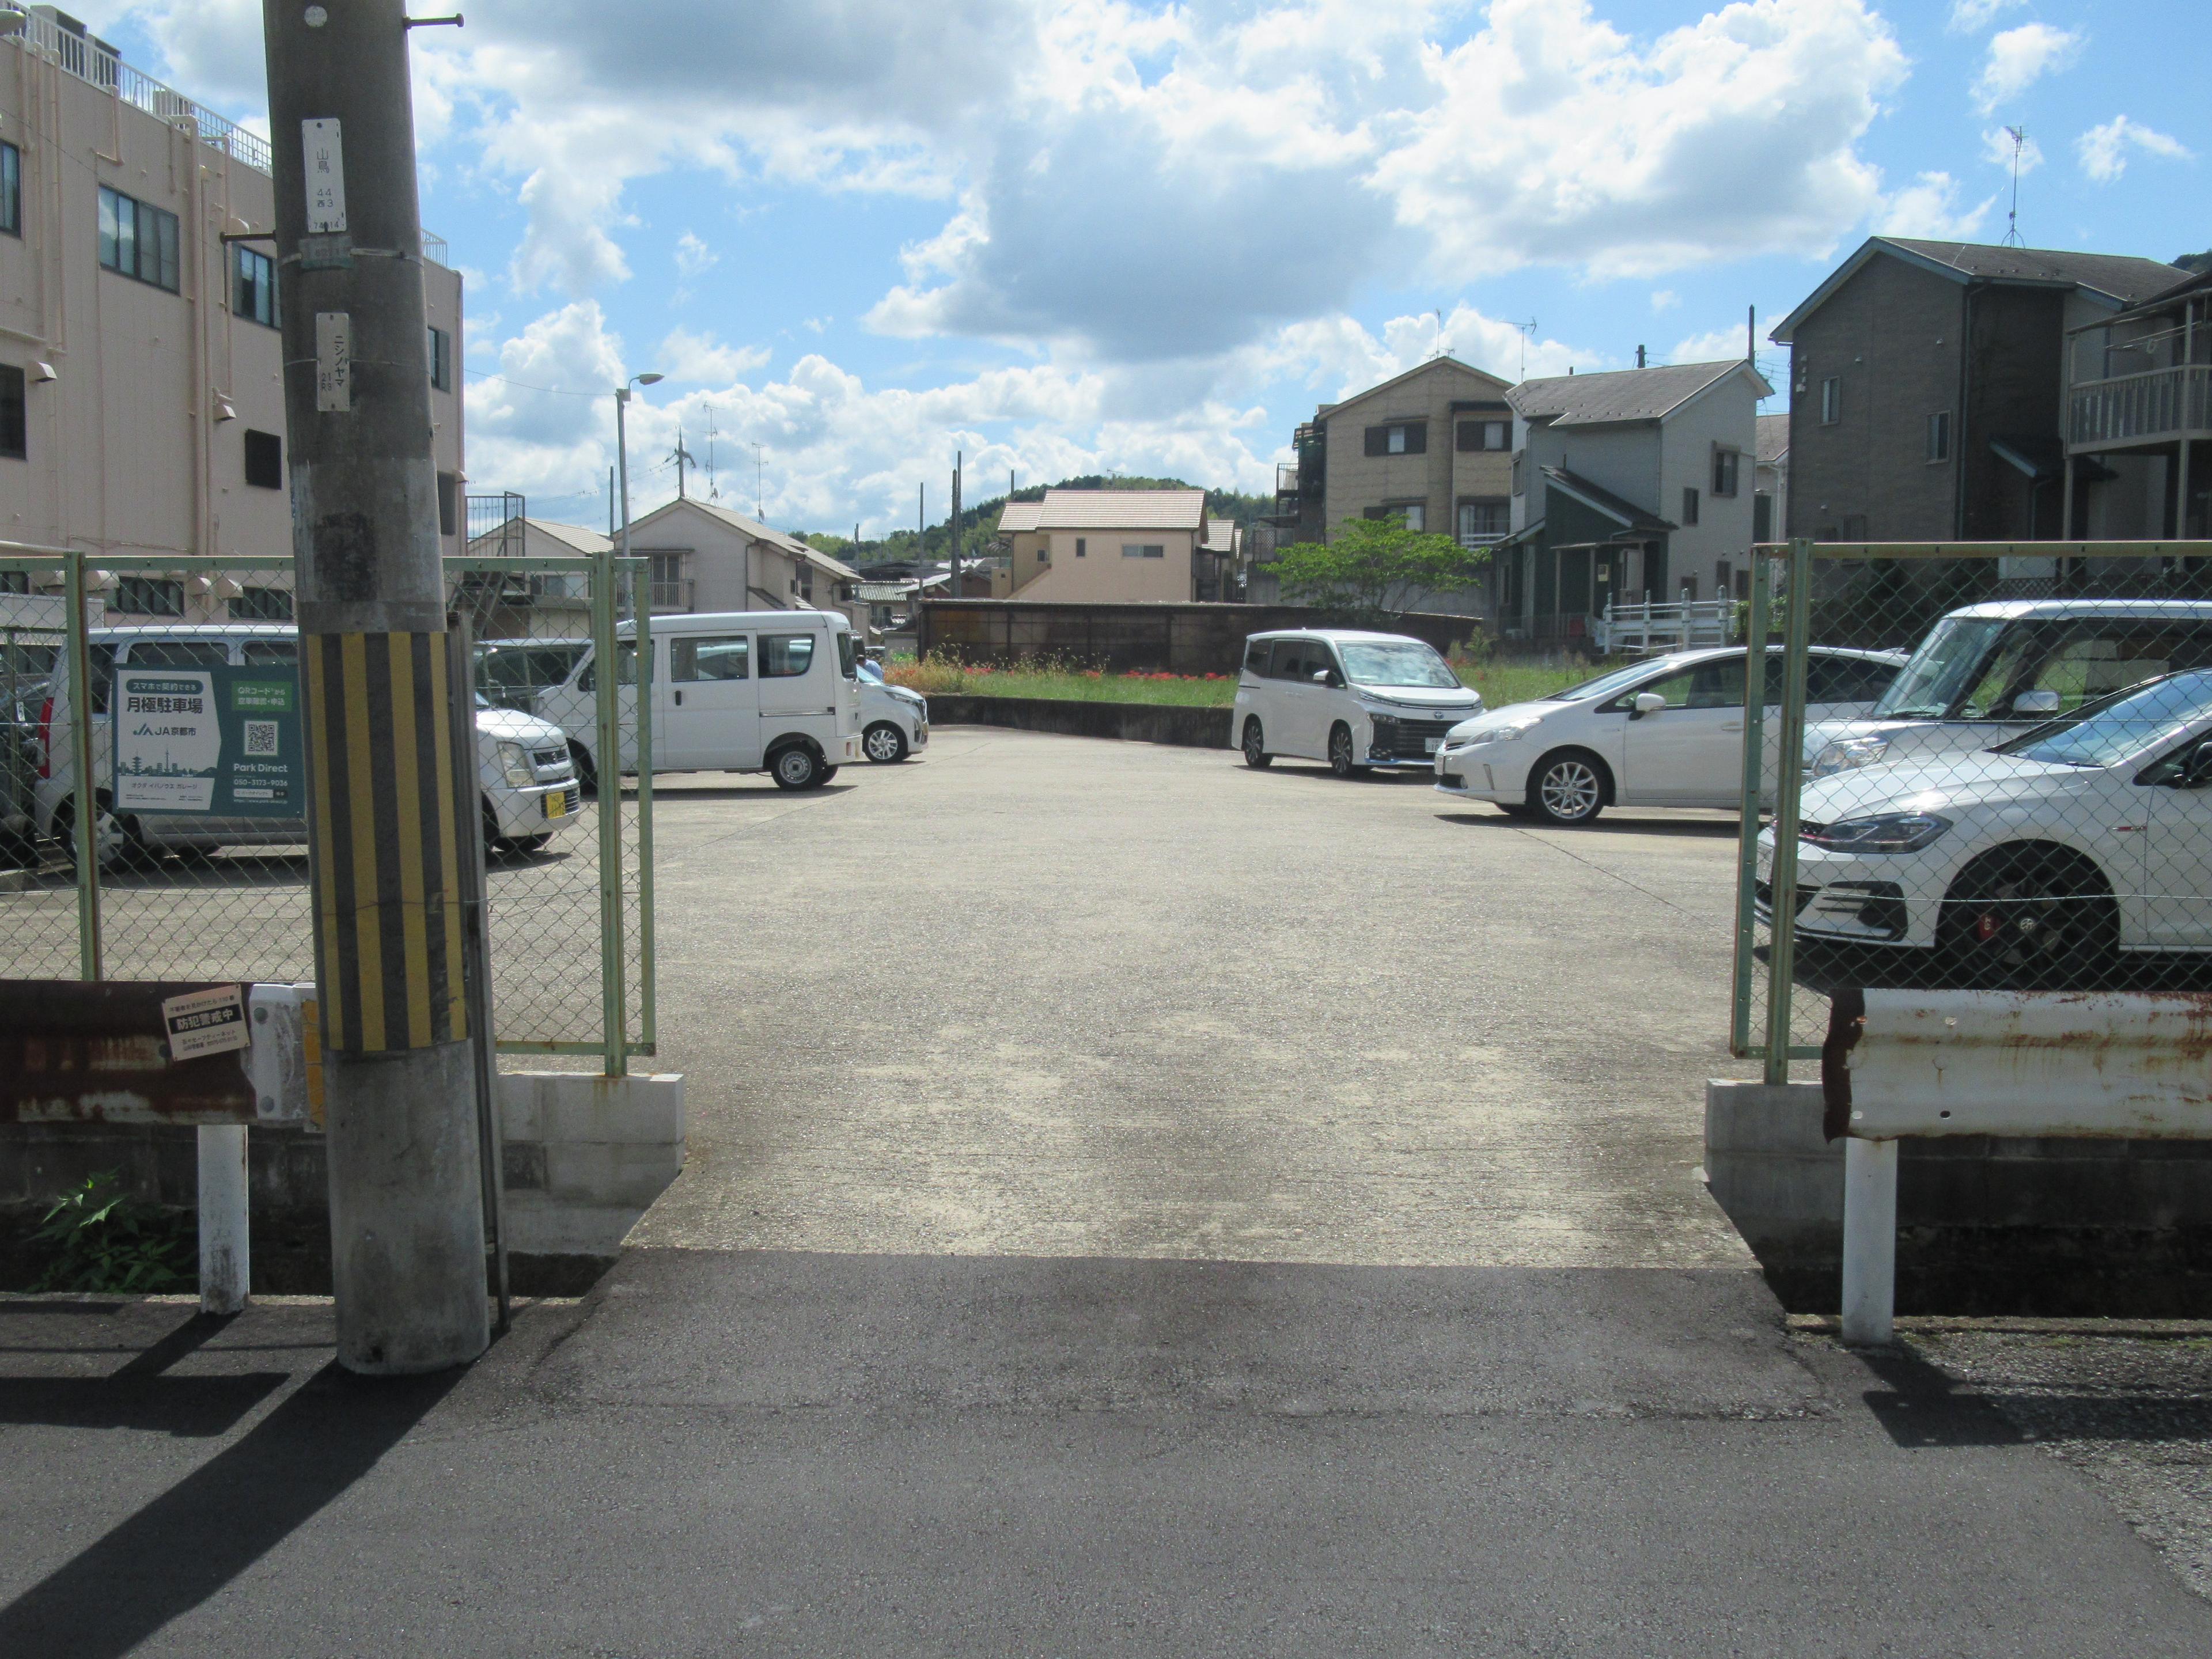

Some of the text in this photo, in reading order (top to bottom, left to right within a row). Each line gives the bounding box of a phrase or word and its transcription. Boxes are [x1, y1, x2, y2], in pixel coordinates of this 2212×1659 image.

[334, 336, 344, 387] ニシノヤマ
[133, 682, 197, 691] スマホで契約できる
[127, 697, 203, 714] 月極駐車場
[154, 727, 196, 736] JA京都市
[233, 763, 288, 772] Park Direct
[176, 1008, 234, 1031] 防犯警戒中
